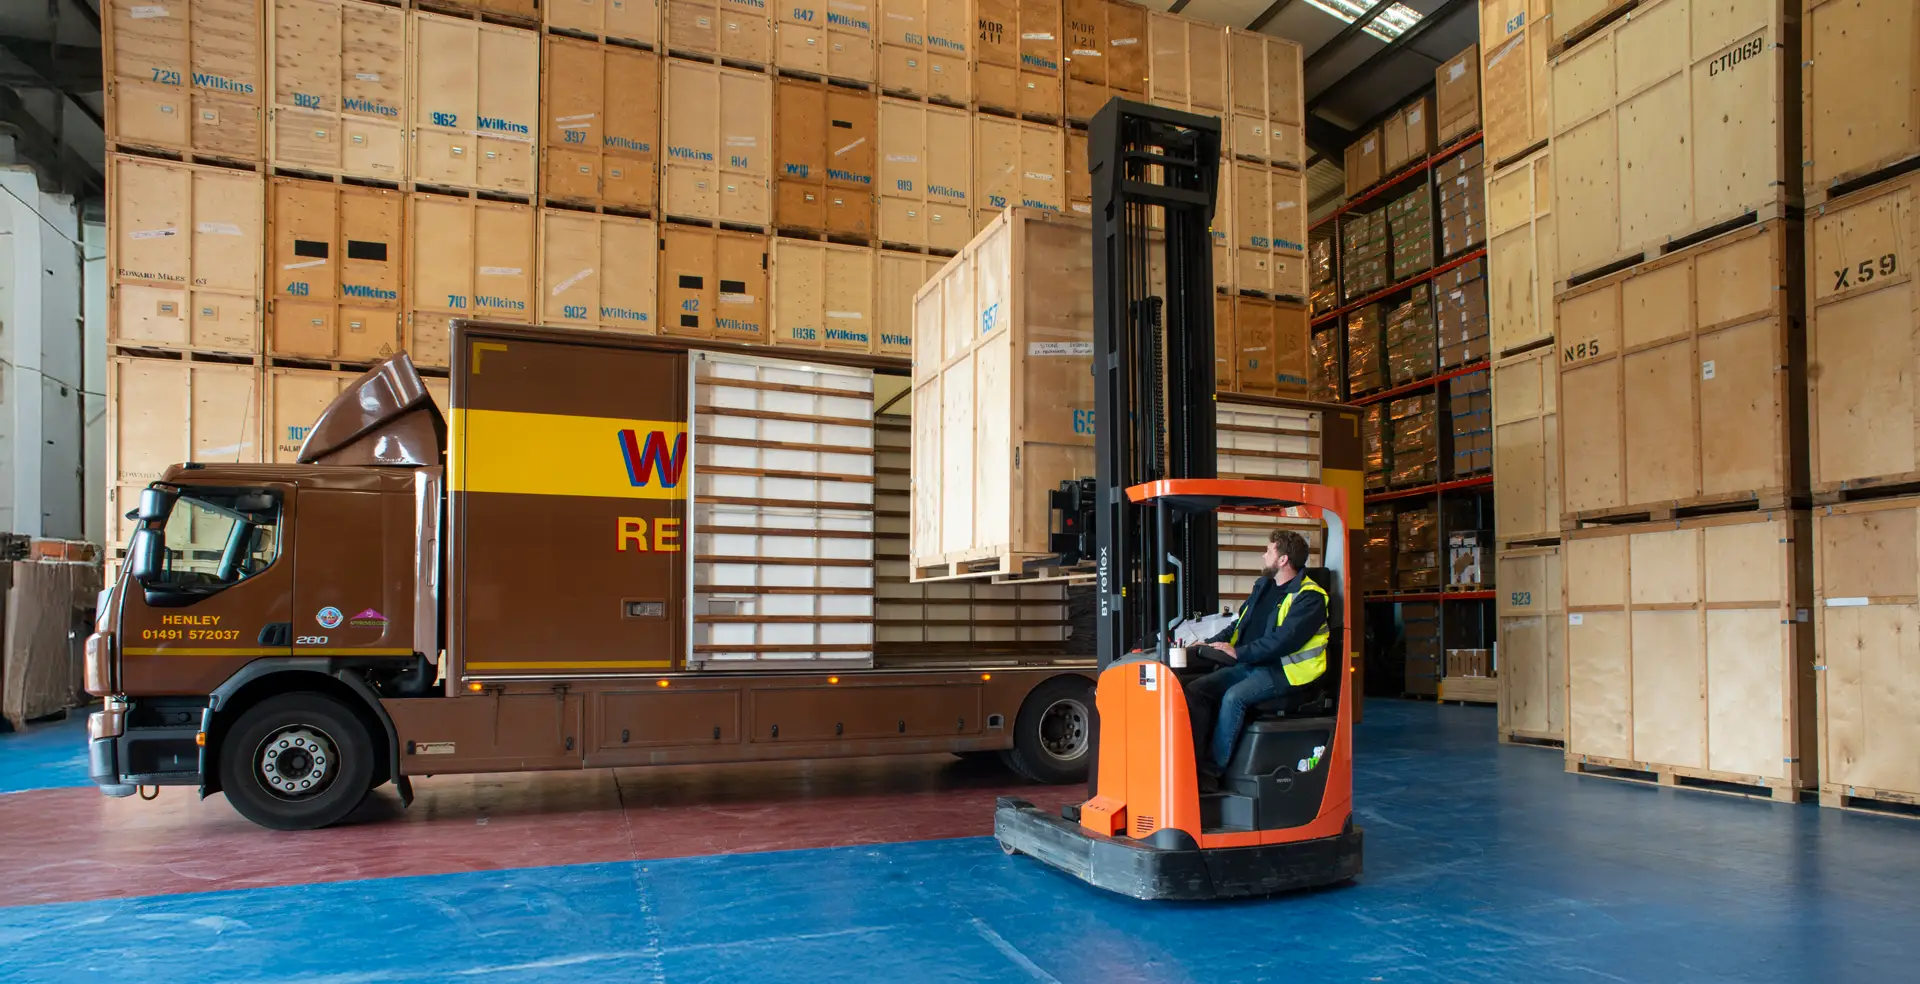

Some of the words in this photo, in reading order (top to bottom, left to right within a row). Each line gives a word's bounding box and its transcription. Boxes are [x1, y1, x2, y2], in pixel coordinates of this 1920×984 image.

[794, 8, 814, 22] 847
[827, 12, 868, 30] Wilkins
[979, 20, 1003, 34] MOR
[1072, 21, 1095, 36] MOR
[928, 36, 965, 52] Wilkins
[980, 31, 1001, 44] 411
[1073, 34, 1096, 48] 120
[1021, 53, 1057, 70] Wilkins
[151, 68, 181, 86] 729
[192, 72, 254, 93] Wilkins
[344, 98, 398, 116] Wilkins
[433, 112, 457, 128] 962
[477, 116, 528, 134] Wilkins
[564, 130, 586, 144] 397
[604, 136, 650, 152] Wilkins
[668, 146, 713, 161] Wilkins
[731, 156, 748, 169] 814
[827, 168, 871, 184] Wilkins
[928, 184, 965, 199] Wilkins
[990, 195, 1006, 208] 752
[1022, 199, 1059, 212] Wilkins
[1251, 236, 1269, 248] 1023
[1273, 238, 1304, 252] Wilkins
[287, 282, 309, 296] 419
[342, 284, 396, 300] Wilkins
[448, 295, 466, 308] 710
[475, 296, 524, 310] Wilkins
[564, 305, 587, 320] 902
[600, 306, 648, 322] Wilkins
[682, 300, 699, 312] 412
[716, 317, 759, 332] Wilkins
[983, 303, 998, 334] 657
[826, 328, 868, 342] Wilkins
[1564, 340, 1598, 362] N85
[1101, 598, 1108, 616] BT
[1512, 592, 1530, 606] 923
[162, 615, 220, 625] HENLEY
[142, 629, 182, 640] 01491
[189, 630, 240, 640] 572037
[296, 636, 328, 644] 280
